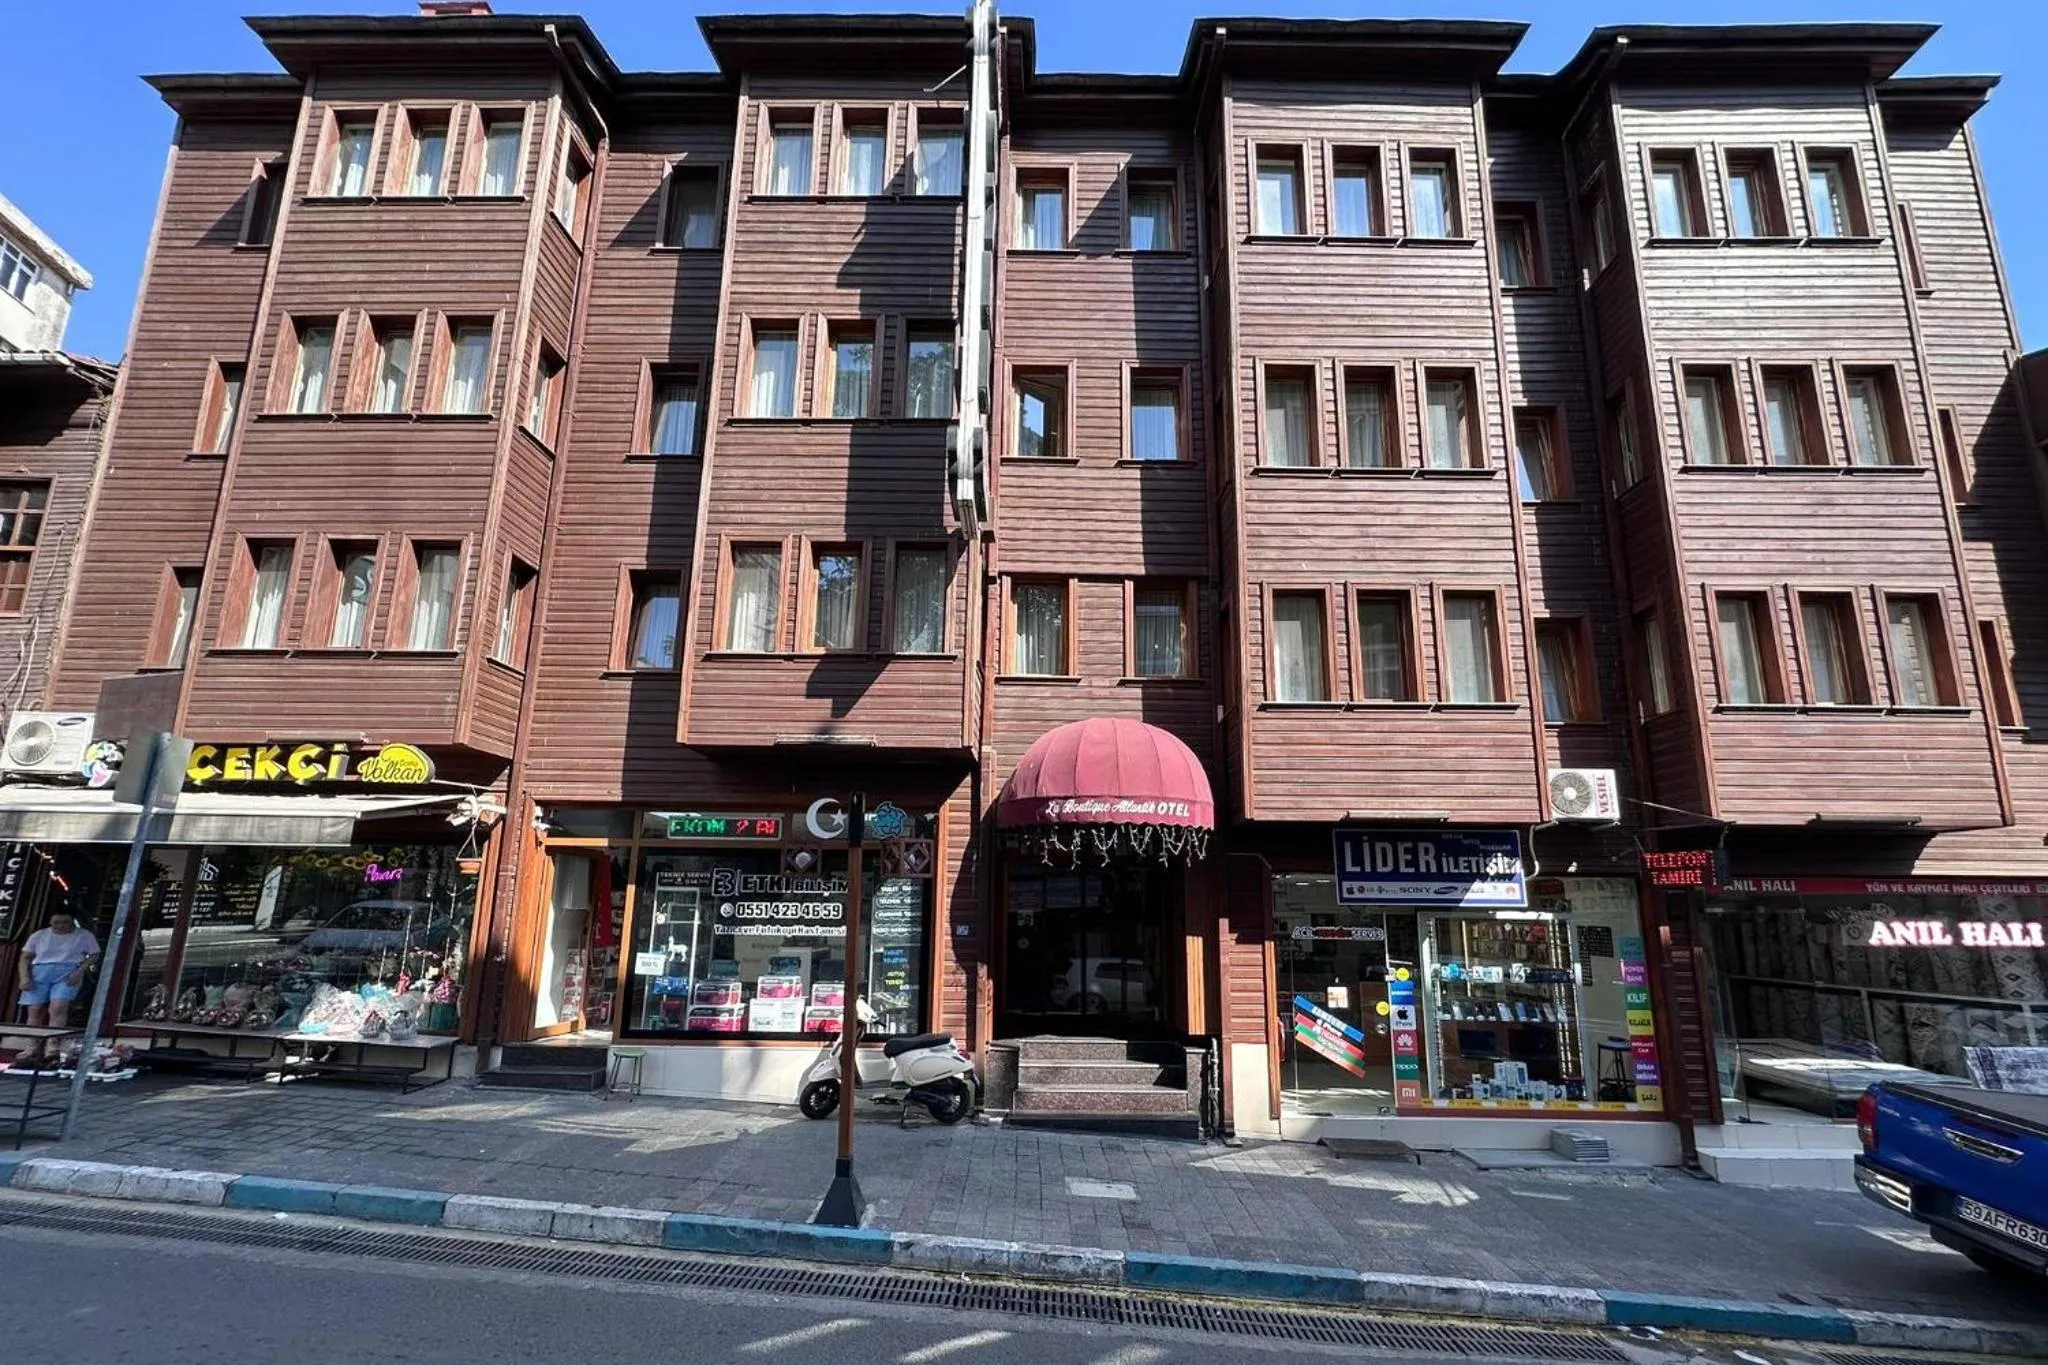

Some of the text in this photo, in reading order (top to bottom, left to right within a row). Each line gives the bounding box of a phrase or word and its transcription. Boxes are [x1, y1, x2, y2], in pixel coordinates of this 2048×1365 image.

[360, 757, 423, 781] Volkan
[1596, 775, 1609, 814] VESTEL
[1045, 801, 1060, 817] La
[1062, 799, 1111, 816] Boutique
[1157, 802, 1190, 817] OTEL
[1344, 835, 1438, 873] LİDER
[1644, 851, 1707, 869] TELEFON
[1399, 886, 1431, 894] SONY
[1761, 880, 1796, 892] HALI
[1953, 884, 1977, 893] HALI
[737, 902, 842, 919] 0551 423 46 59
[1868, 920, 2045, 947] ANIL HALI
